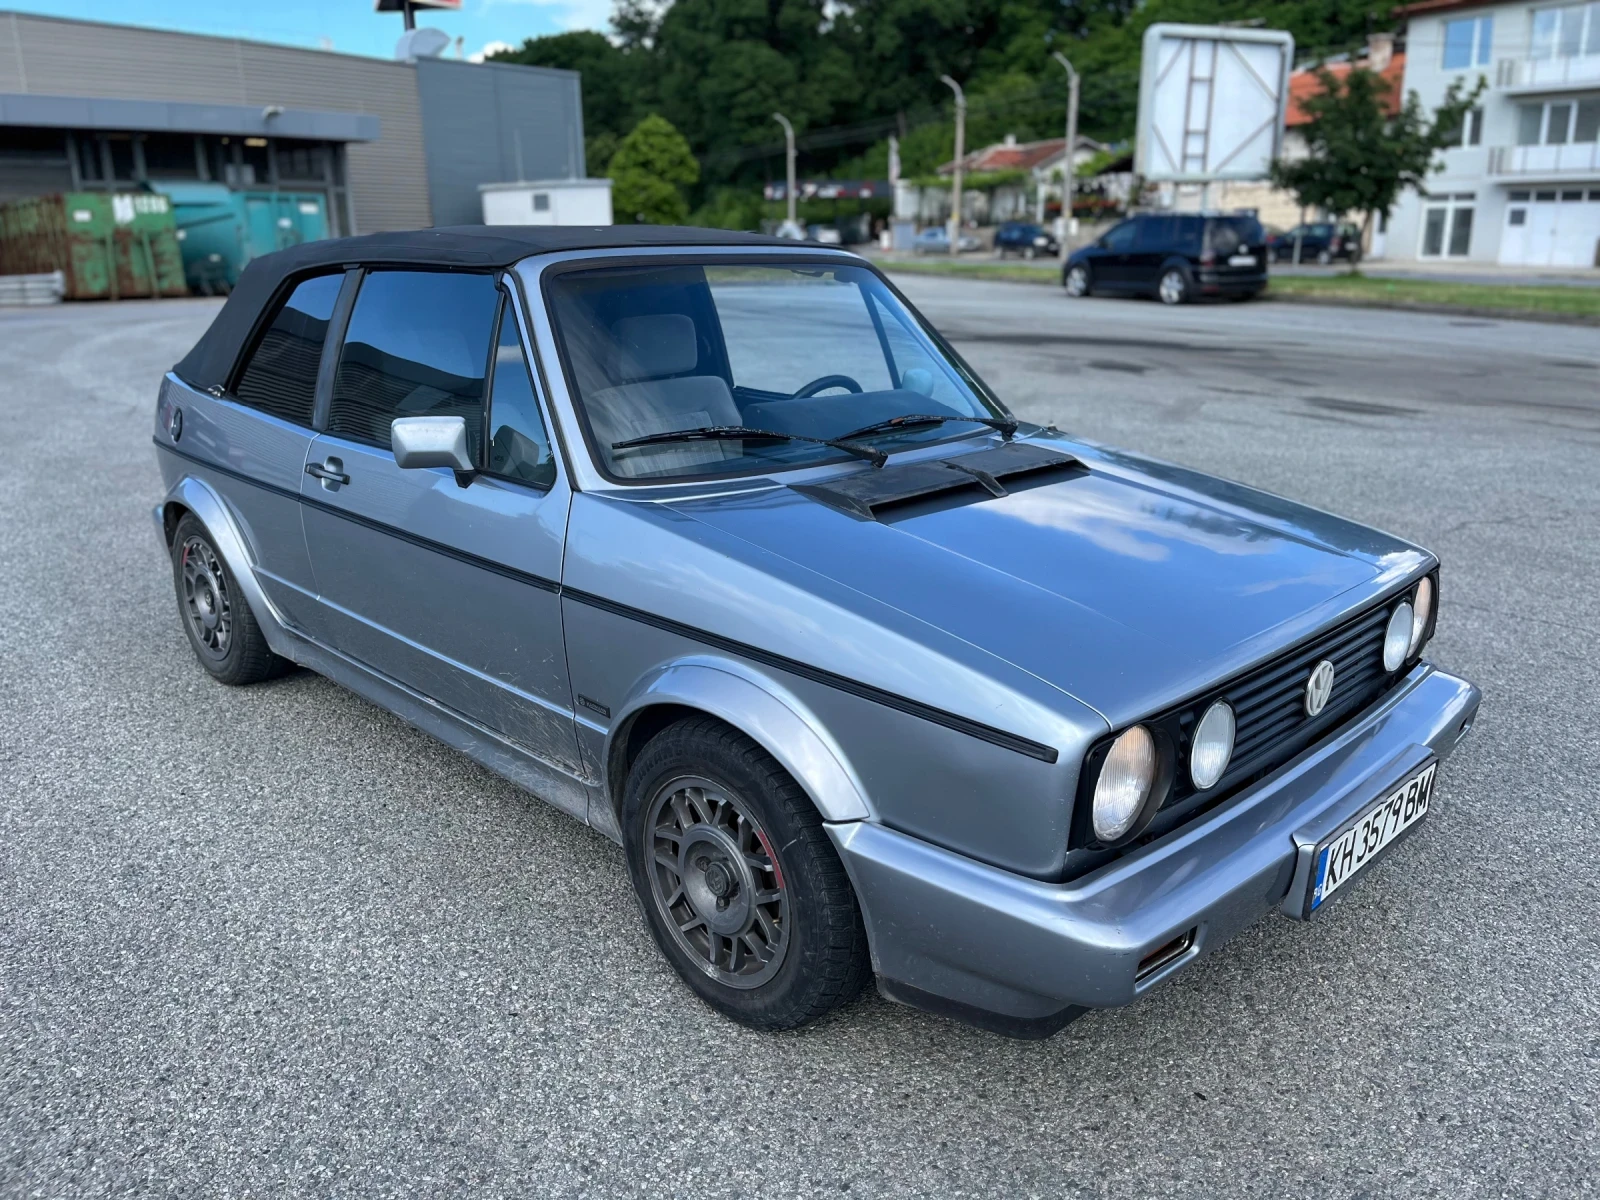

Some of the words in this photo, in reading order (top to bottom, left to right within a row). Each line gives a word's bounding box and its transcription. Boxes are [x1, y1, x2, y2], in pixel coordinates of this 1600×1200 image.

[1306, 660, 1335, 717] VW
[1325, 830, 1357, 891] KH
[1356, 793, 1404, 863] 3579
[1403, 770, 1432, 824] BM
